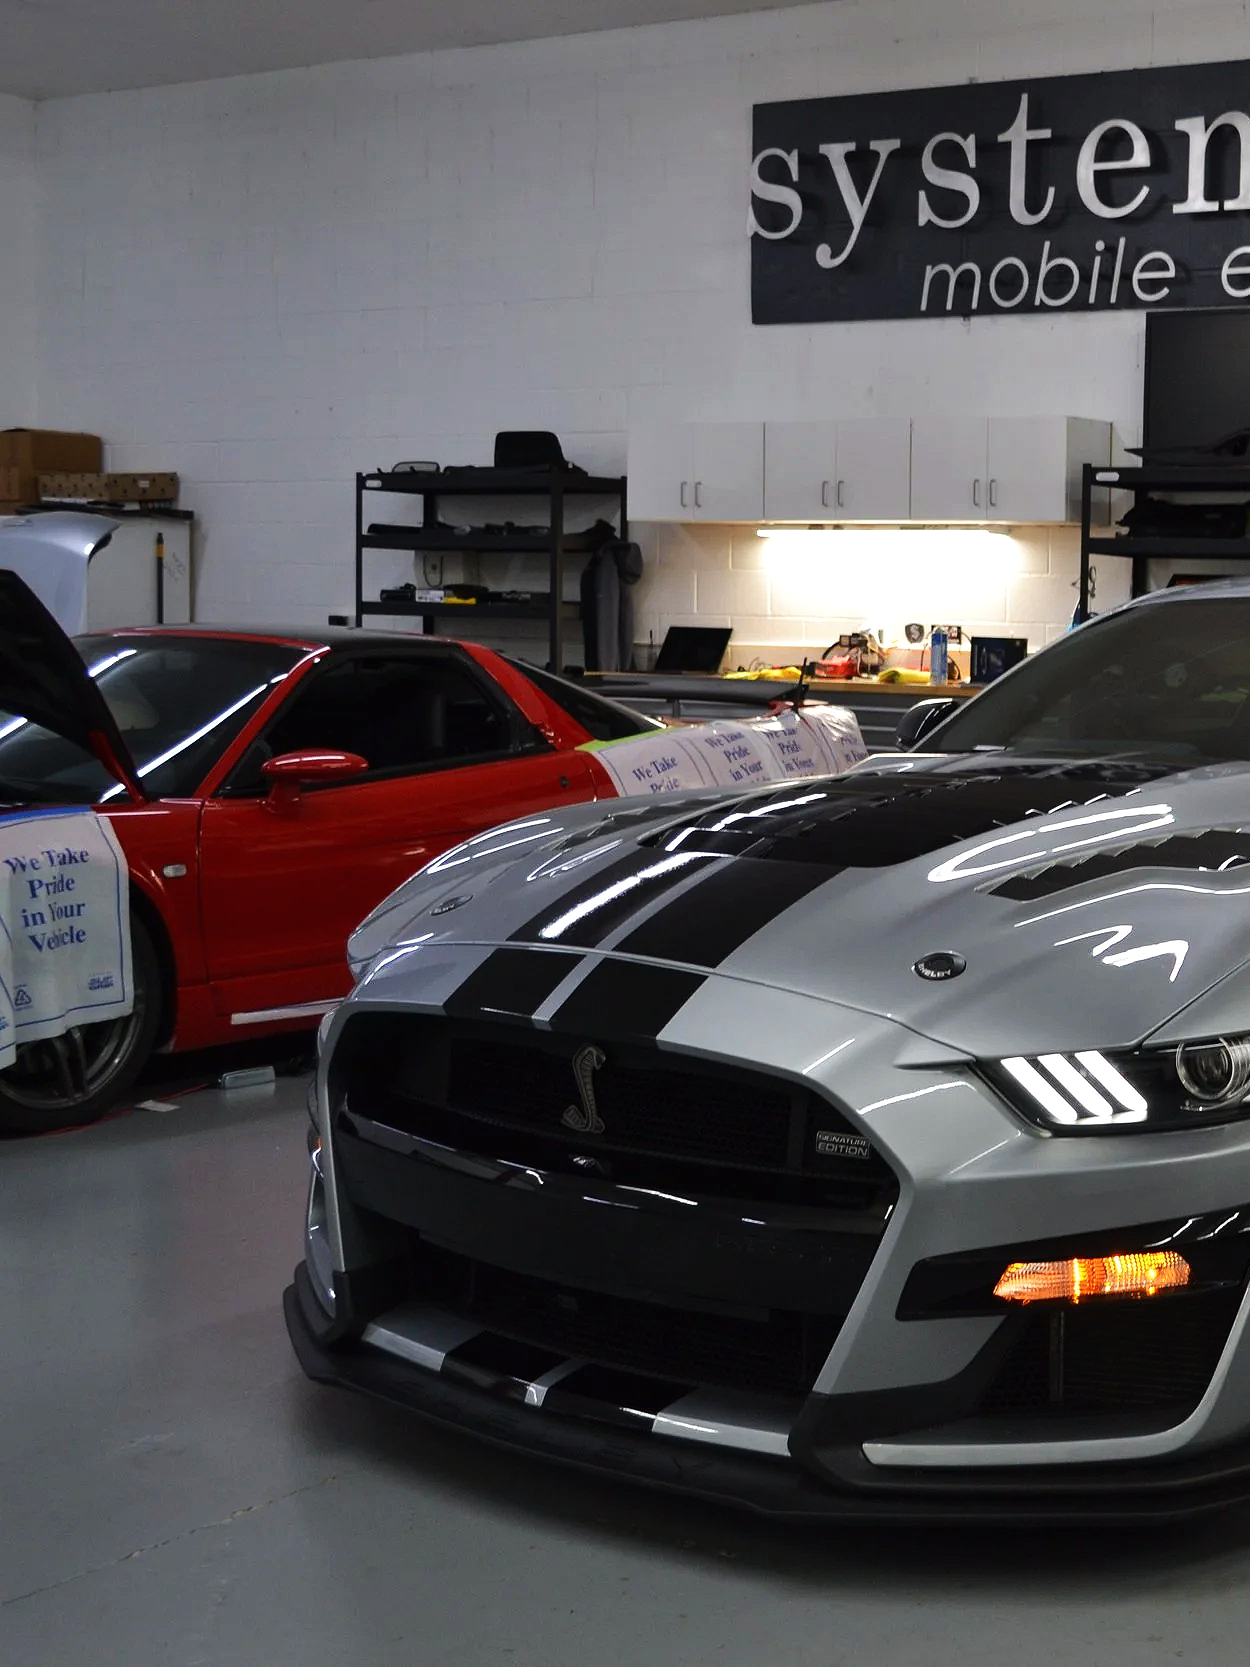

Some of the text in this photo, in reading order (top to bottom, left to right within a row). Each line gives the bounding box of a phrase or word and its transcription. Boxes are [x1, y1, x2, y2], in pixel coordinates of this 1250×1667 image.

[920, 236, 1176, 311] mobile
[723, 746, 751, 763] Pride
[632, 756, 679, 782] We Take
[729, 768, 744, 782] in
[740, 760, 764, 776] Your
[3, 847, 90, 875] We Take
[26, 873, 76, 899] Pride
[21, 901, 86, 928] in Your
[818, 1142, 868, 1156] EDITION
